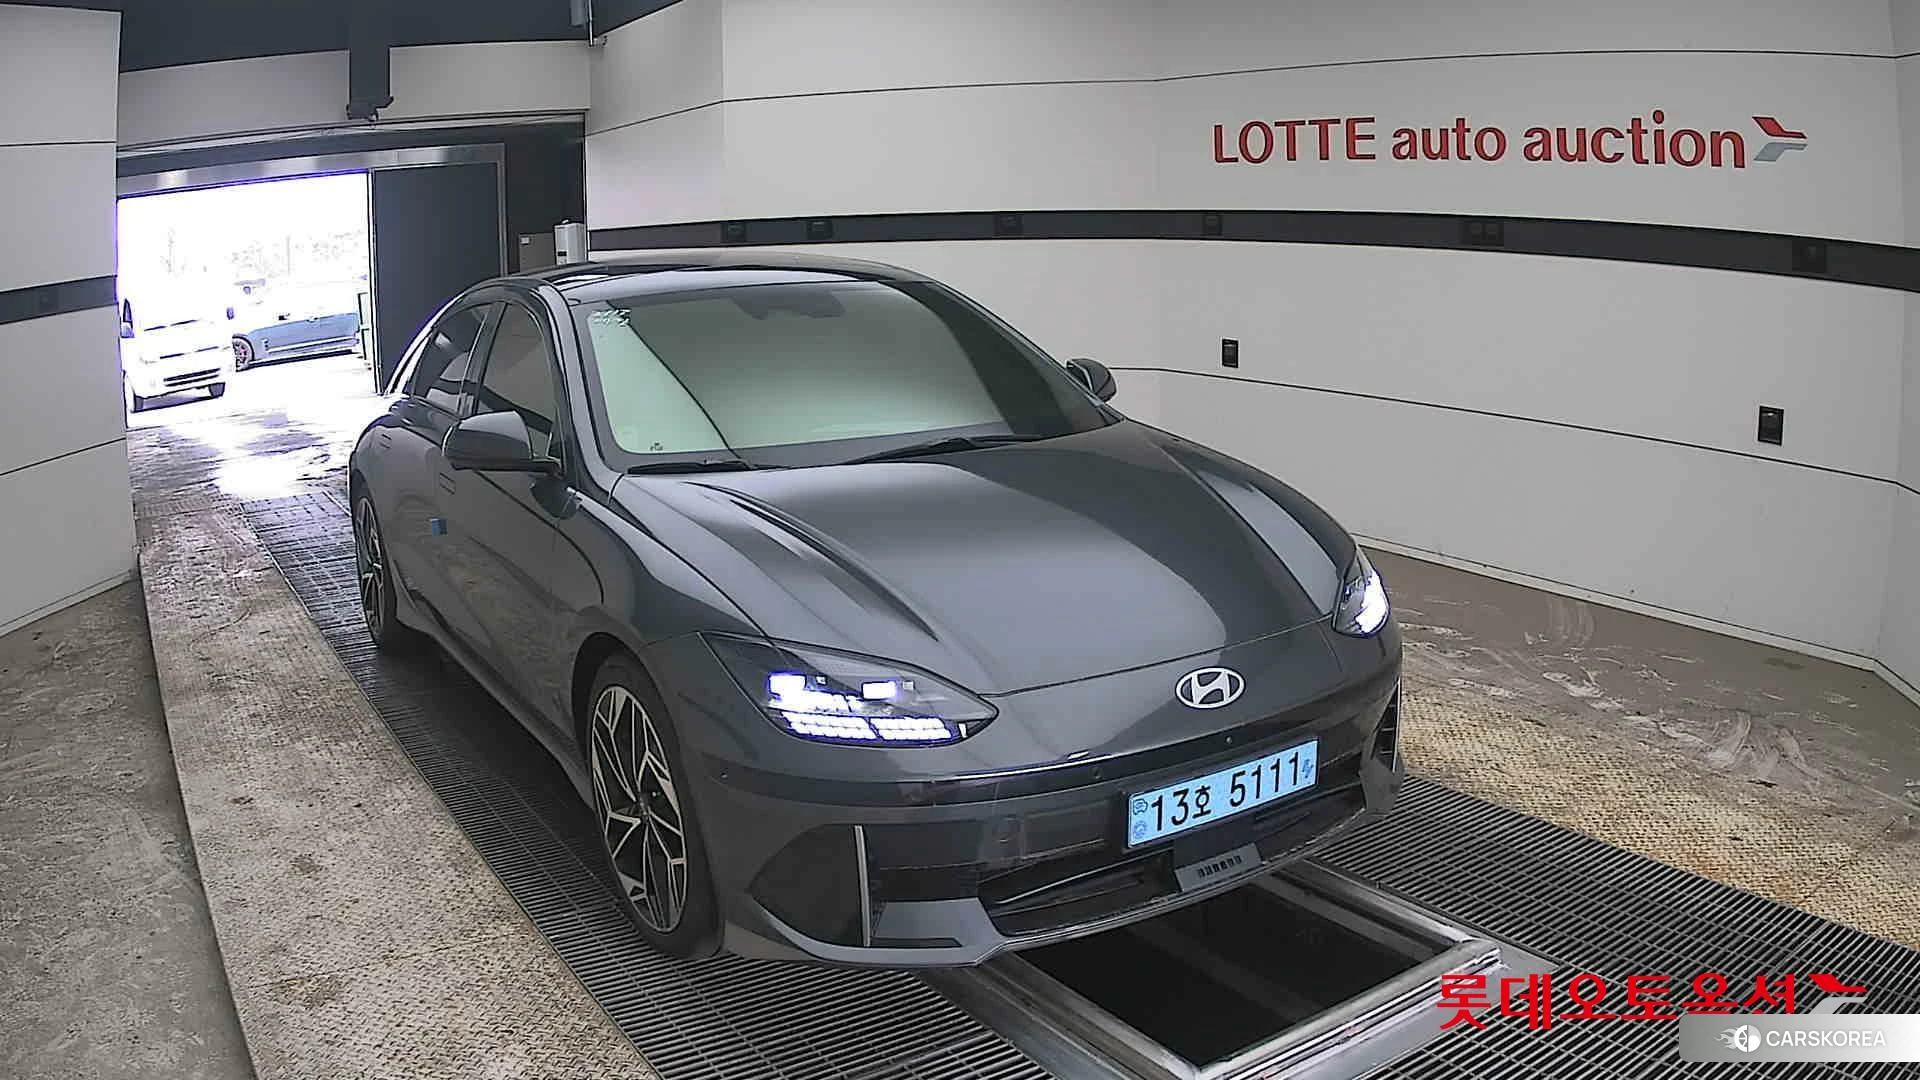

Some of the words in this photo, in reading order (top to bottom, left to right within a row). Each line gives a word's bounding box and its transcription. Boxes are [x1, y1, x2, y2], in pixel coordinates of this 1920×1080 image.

[1212, 116, 1377, 165] LOTTE
[1391, 117, 1508, 162] auto
[1522, 109, 1746, 169] auction
[1150, 784, 1212, 832] 13호
[1229, 751, 1300, 808] 5111
